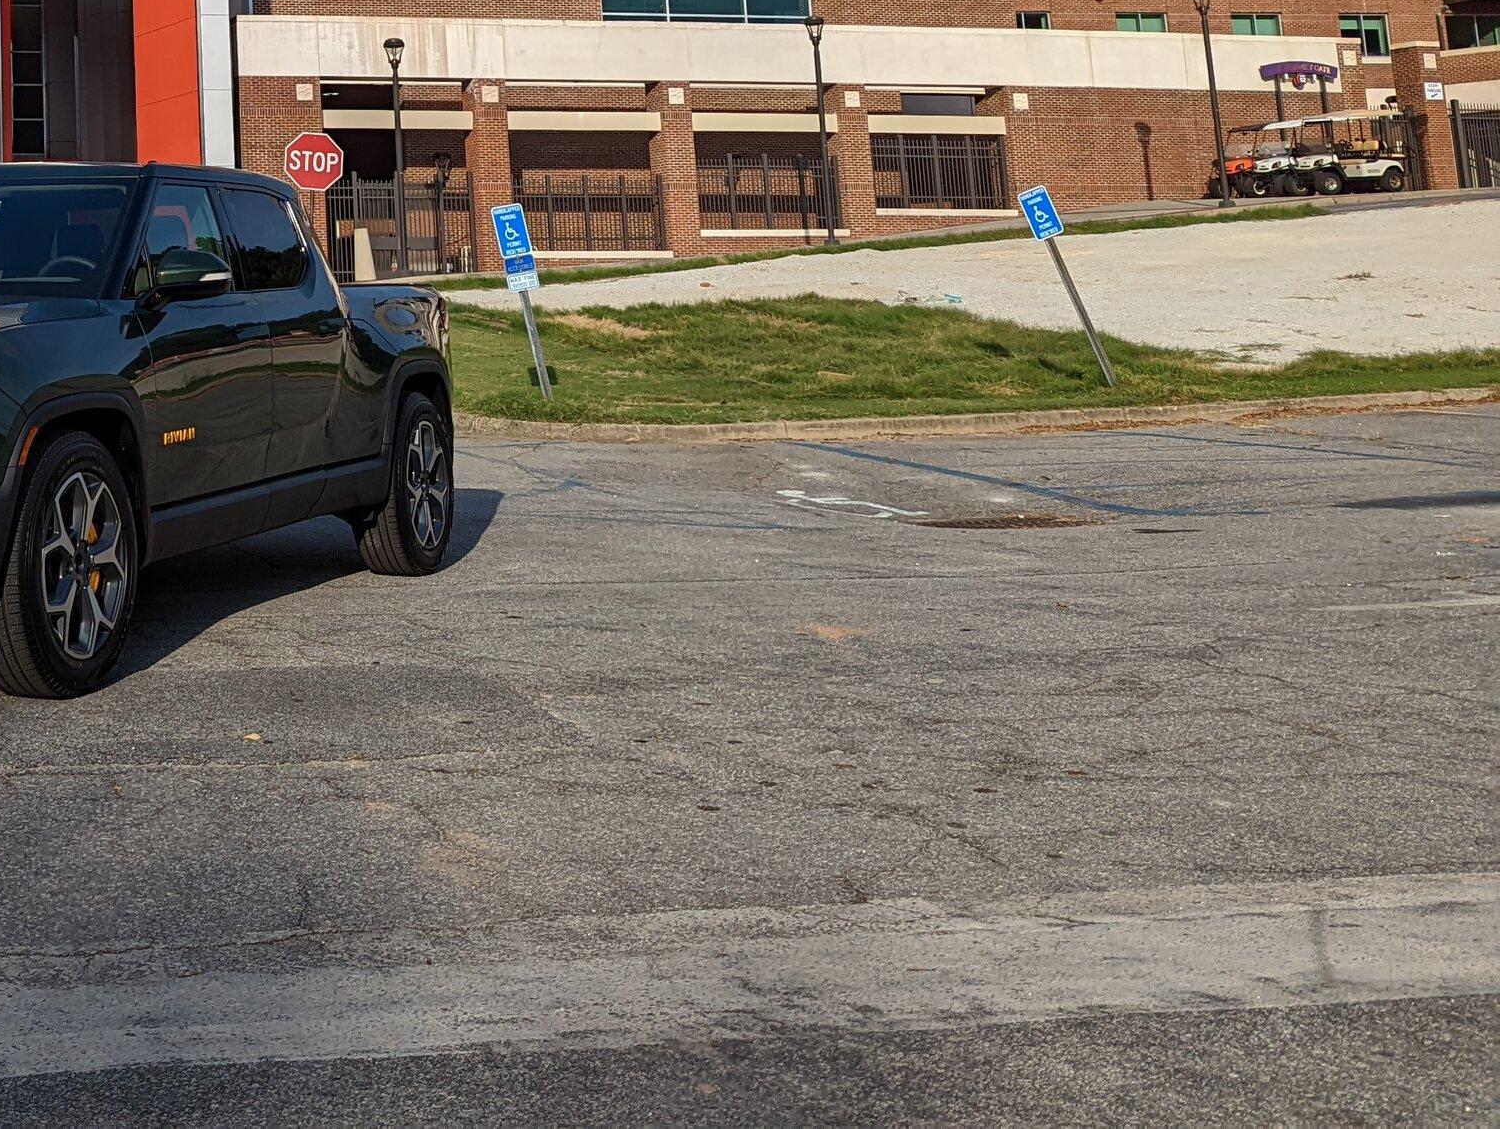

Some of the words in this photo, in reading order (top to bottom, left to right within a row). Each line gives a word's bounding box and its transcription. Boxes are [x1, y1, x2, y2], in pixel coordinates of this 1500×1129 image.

[289, 150, 339, 173] STOP
[499, 213, 517, 222] PARKING
[506, 240, 522, 248] PERMIT
[163, 427, 196, 445] RIVIAN
